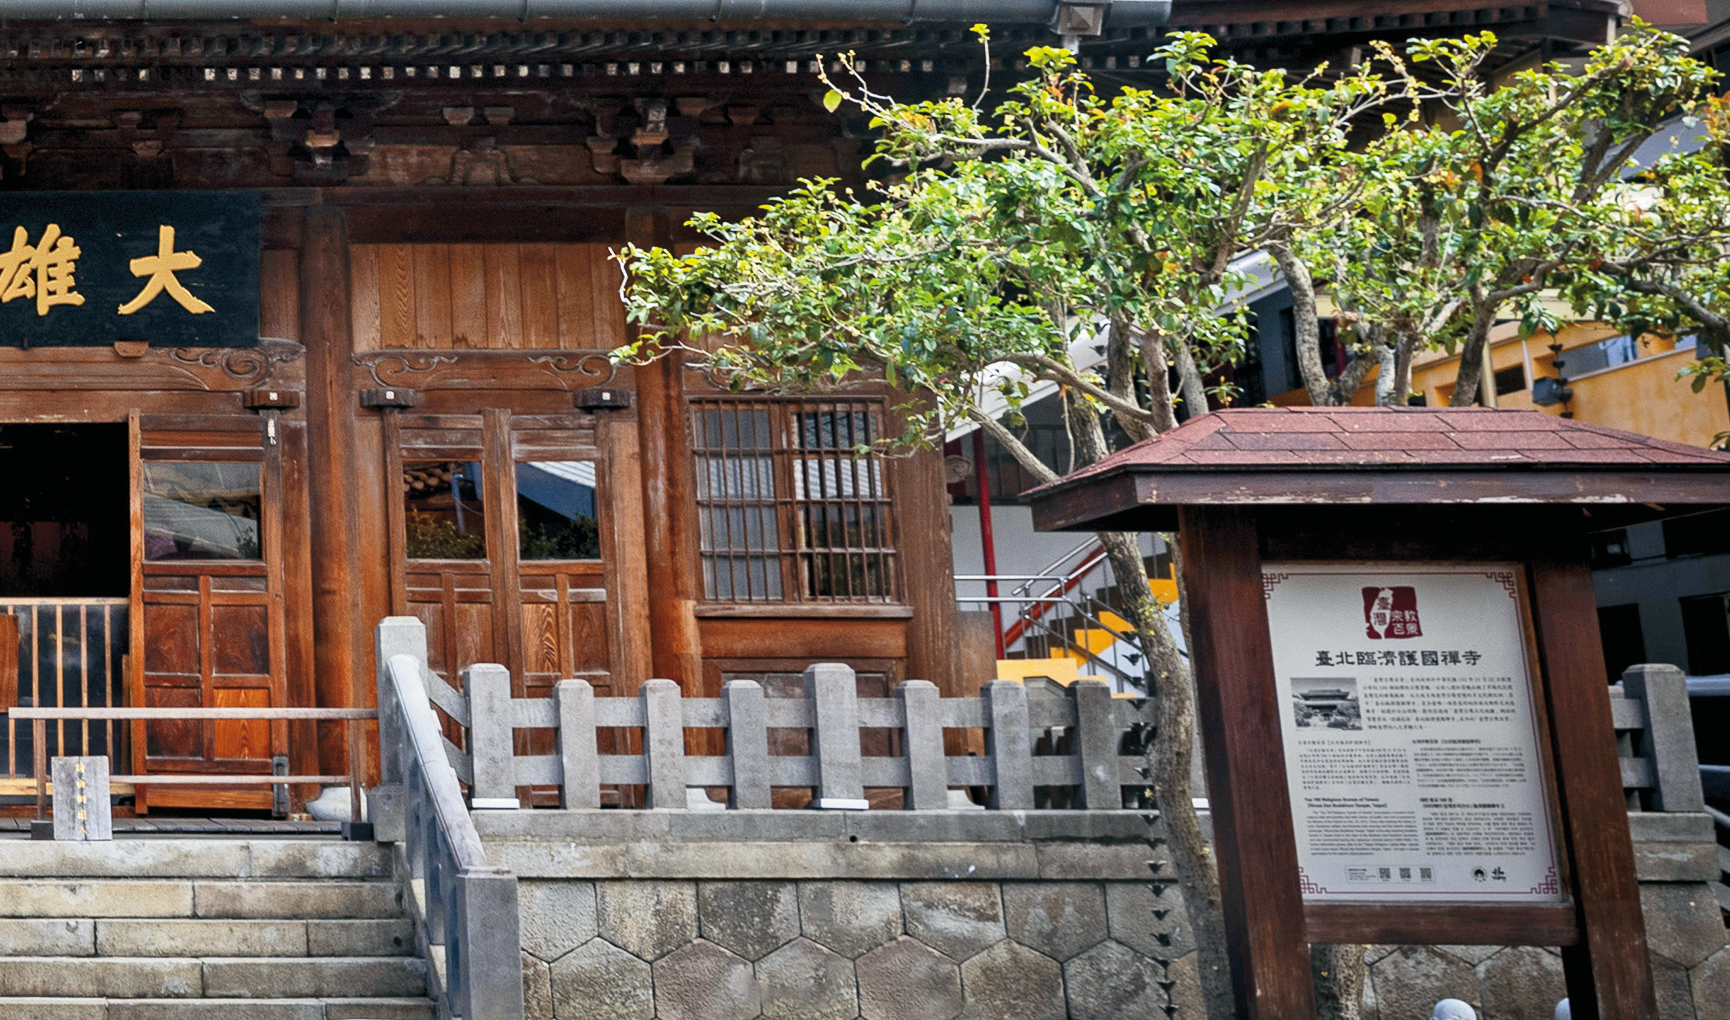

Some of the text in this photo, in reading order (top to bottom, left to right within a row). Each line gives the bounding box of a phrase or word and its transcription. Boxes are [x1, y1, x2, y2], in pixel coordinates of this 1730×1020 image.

[1315, 650, 1482, 667] 臺北臨濟護國禪寺
